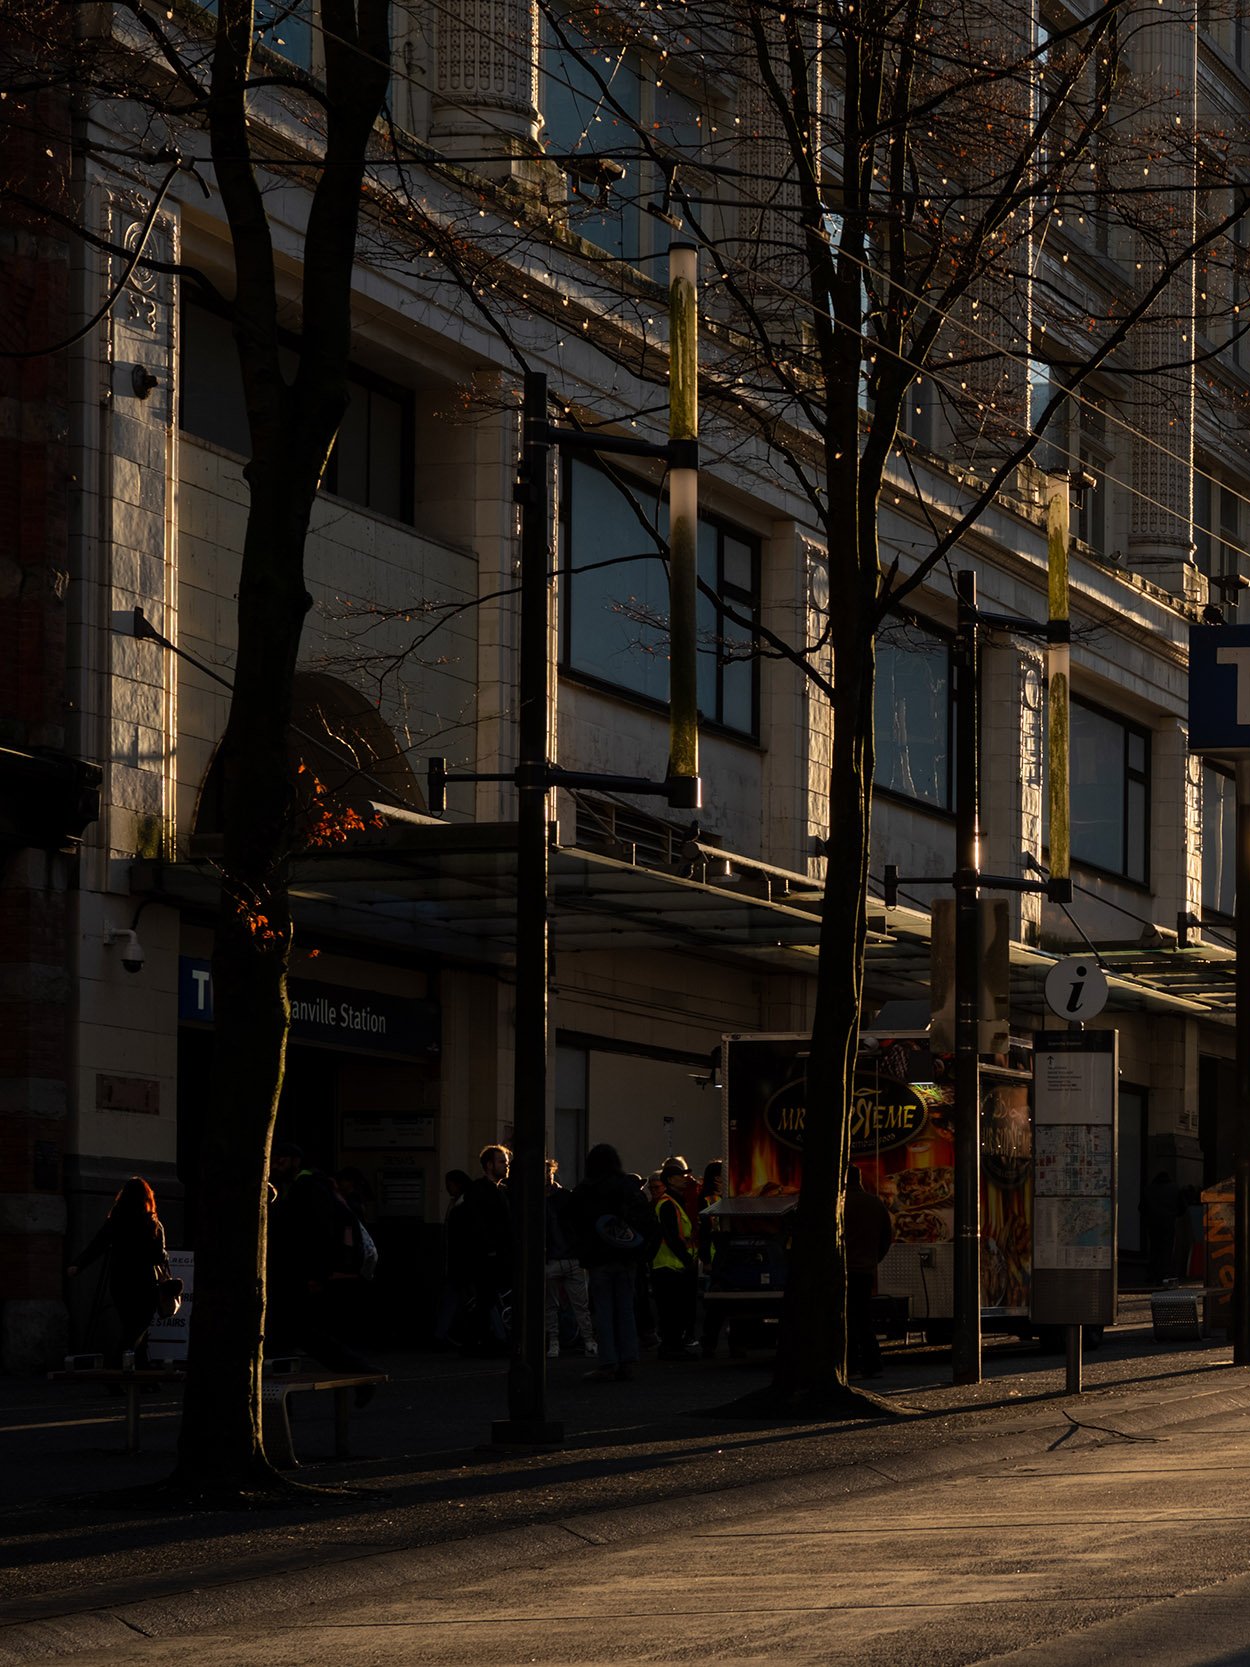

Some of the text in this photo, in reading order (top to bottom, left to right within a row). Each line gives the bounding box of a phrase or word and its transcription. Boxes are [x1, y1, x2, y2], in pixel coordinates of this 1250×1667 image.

[191, 969, 210, 1011] T
[291, 999, 387, 1033] anville Station
